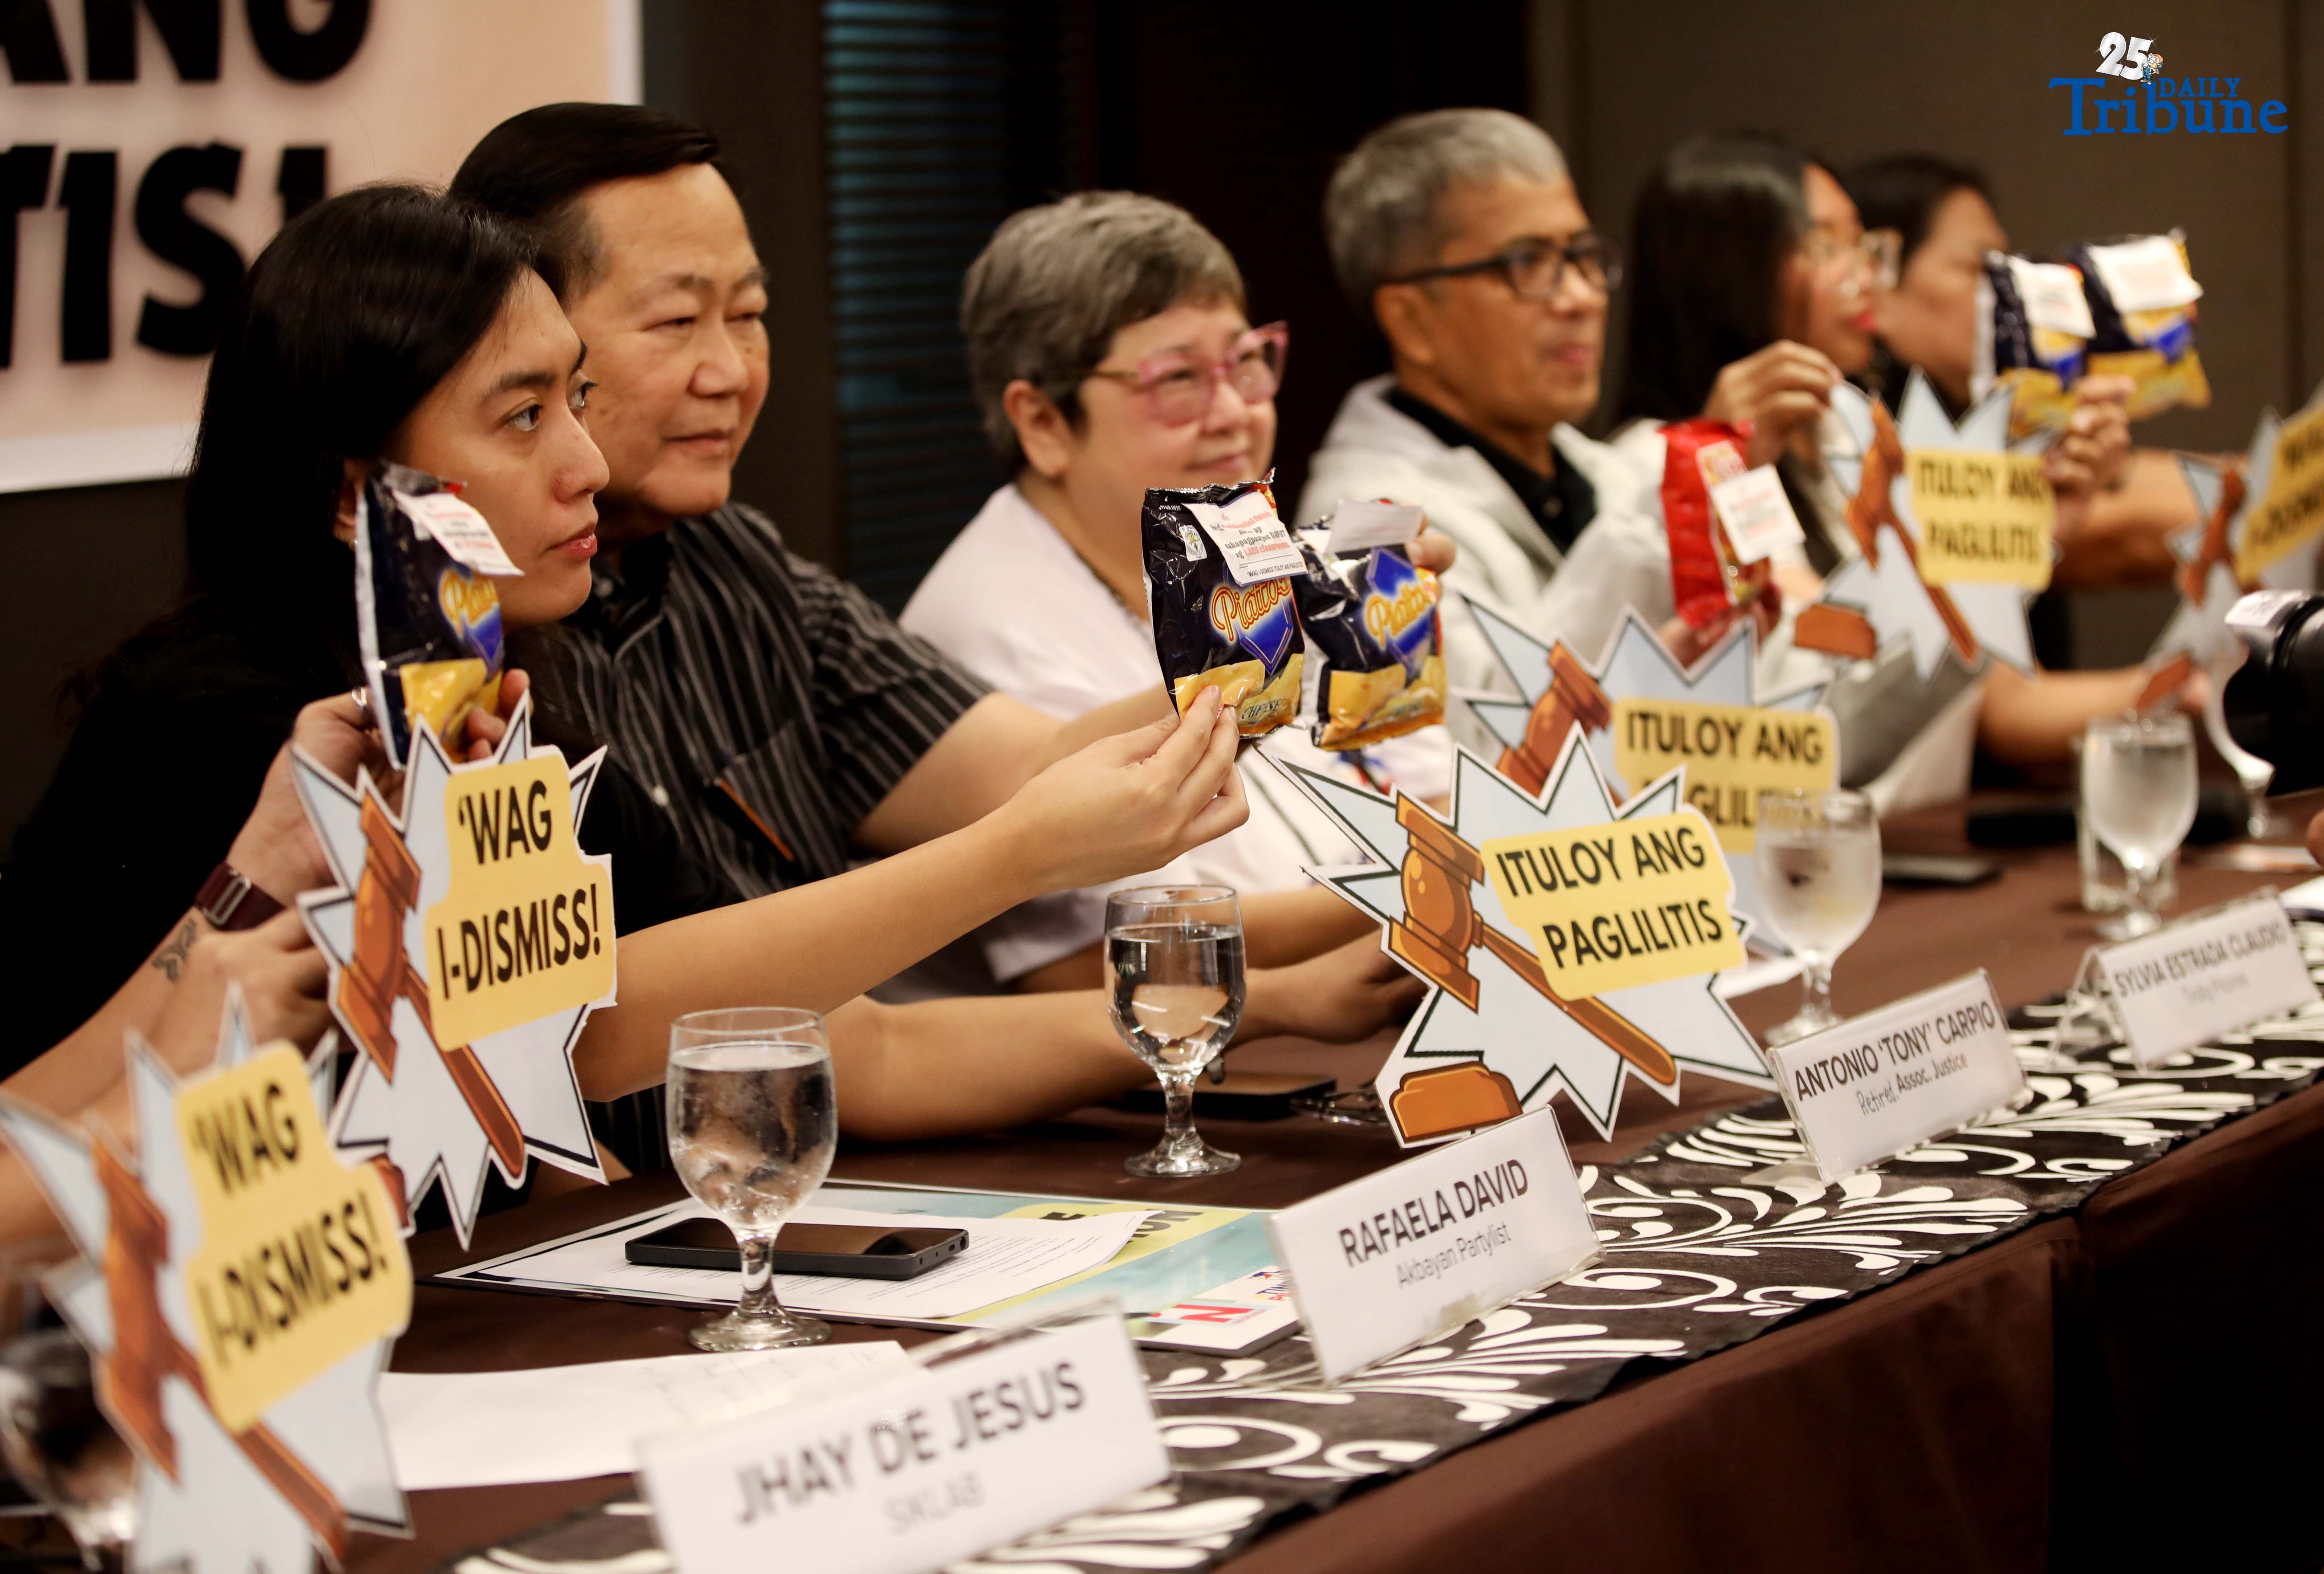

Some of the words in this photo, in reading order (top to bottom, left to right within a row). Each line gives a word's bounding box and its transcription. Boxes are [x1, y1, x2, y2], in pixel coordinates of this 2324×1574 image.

[1627, 710, 1743, 757] ITULOY
[1755, 723, 1824, 765] ANG
[458, 779, 552, 865] 'WAG
[1496, 837, 1622, 897] ITULOY
[1632, 827, 1706, 877] ANG
[437, 883, 601, 1000] I-DISMISS!
[1542, 899, 1722, 969] PAGLILITIS
[2114, 959, 2166, 997] SYLVIA
[1795, 1044, 1879, 1102] ANTONIO
[1878, 1022, 1932, 1065] 'TONY'
[1936, 1001, 1996, 1045] CARPIO
[1895, 1067, 1933, 1094] Assoc.
[1932, 1052, 1968, 1081] Justice
[1339, 1190, 1457, 1268] RAFAELA
[1453, 1159, 1529, 1219] DAVID
[196, 1190, 389, 1370] I-DISMISS!
[1396, 1246, 1459, 1289] Akbayan
[1456, 1221, 1511, 1264] Partylist
[735, 1431, 857, 1526] JHAY
[868, 1408, 937, 1475] DE
[950, 1361, 1086, 1451] JESUS
